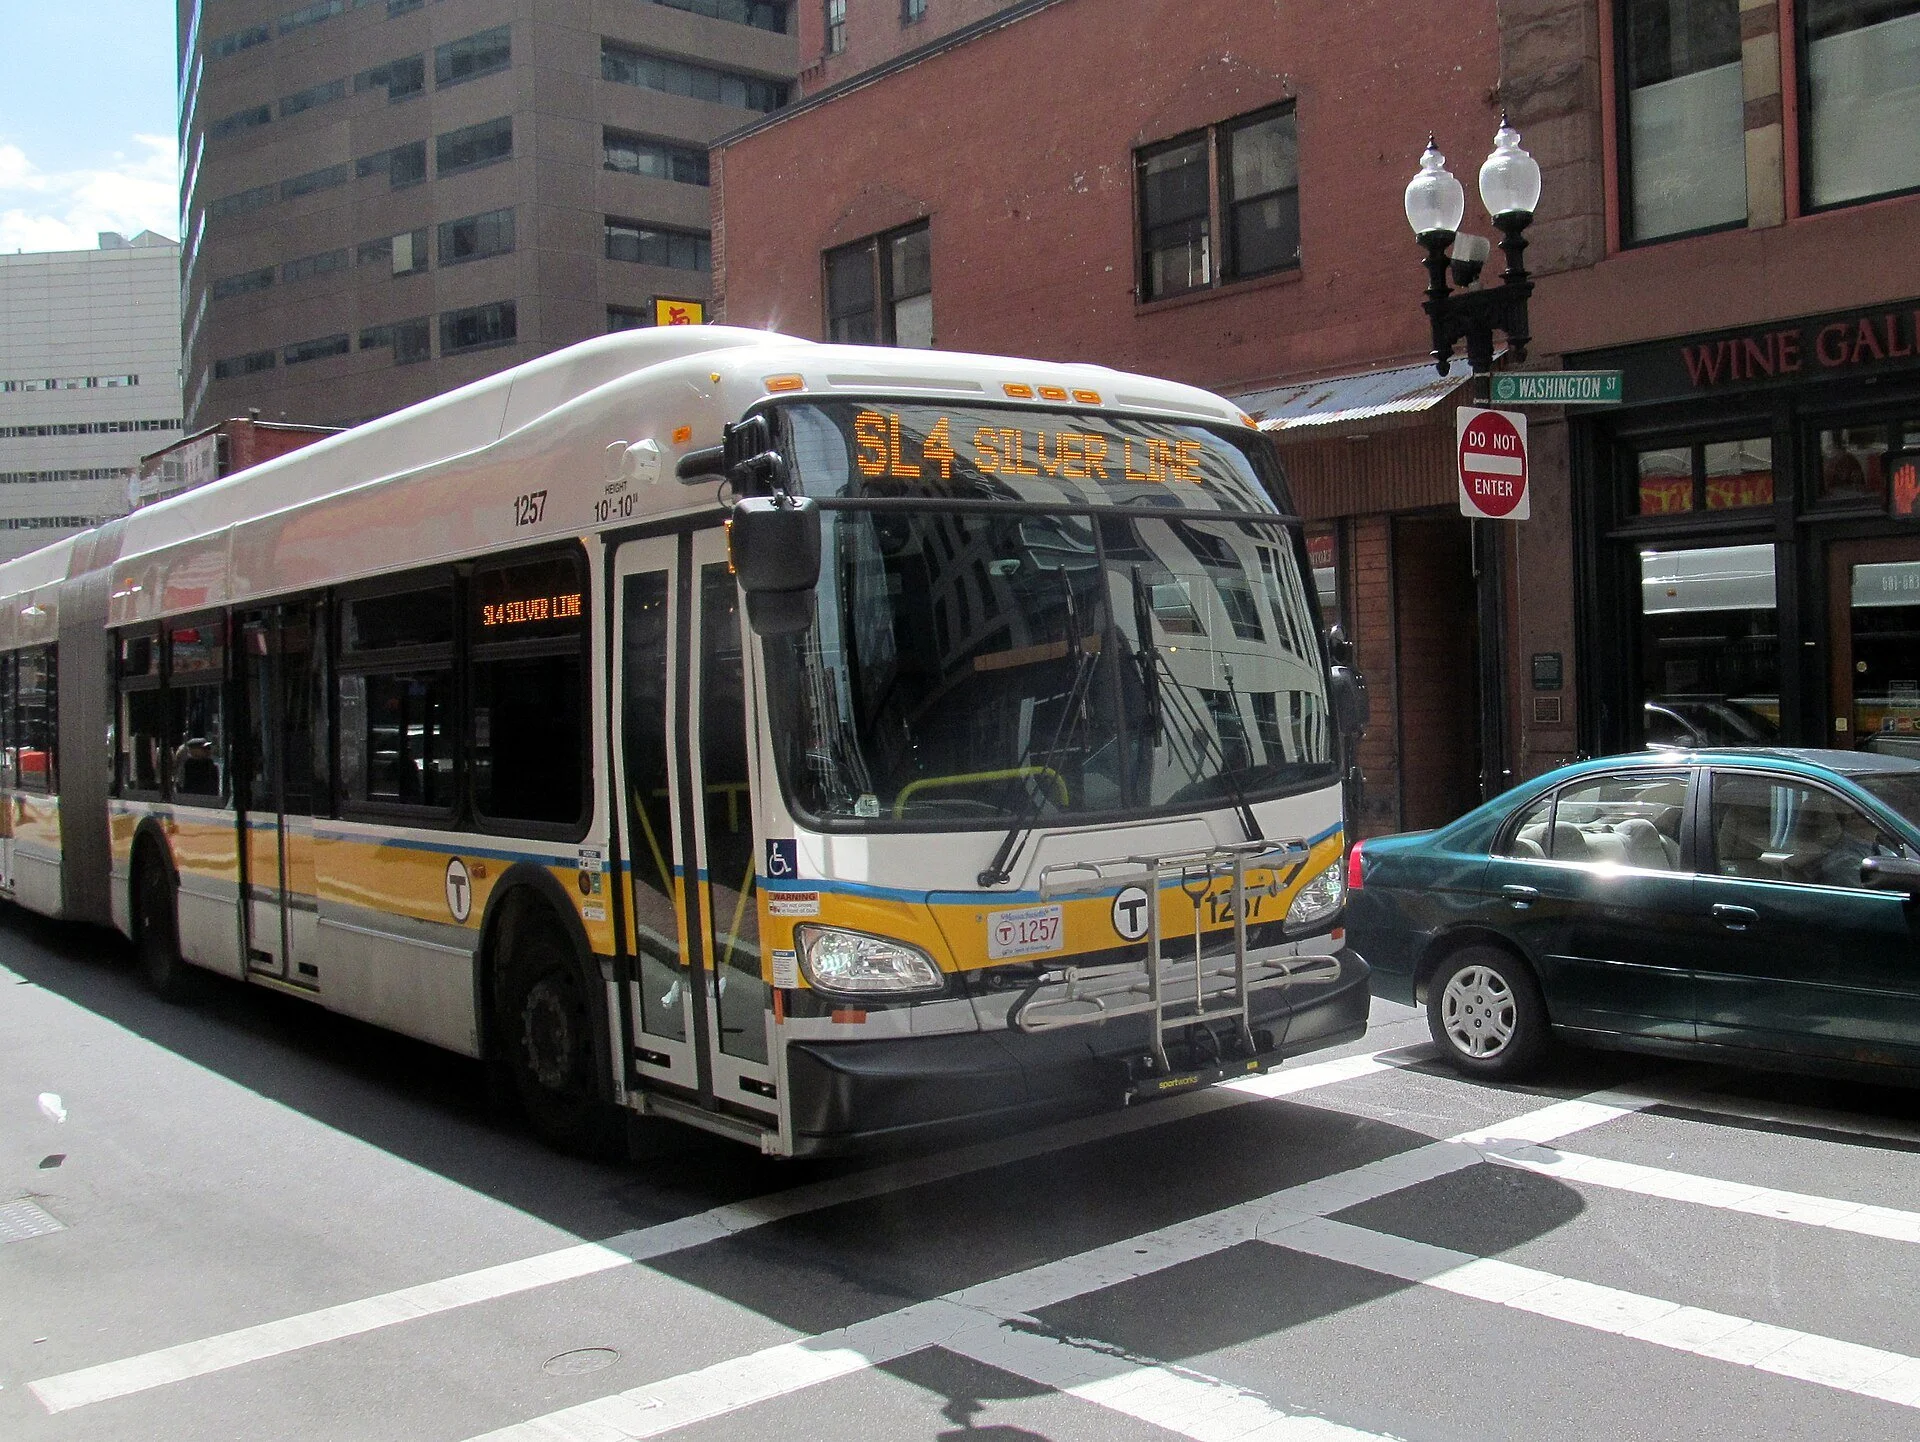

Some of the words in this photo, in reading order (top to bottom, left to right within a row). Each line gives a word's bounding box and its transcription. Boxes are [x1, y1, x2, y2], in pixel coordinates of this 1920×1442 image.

[1682, 329, 1802, 386] WINE
[1519, 377, 1600, 398] WASHINGTON
[1606, 377, 1616, 390] ST
[1469, 431, 1486, 448] DO
[1494, 434, 1516, 451] NOT
[973, 427, 1108, 479] SILVER
[1125, 437, 1202, 483] LINE
[605, 481, 627, 495] HEIGHT
[1475, 479, 1513, 496] ENTER
[514, 490, 547, 526] 1257
[506, 599, 548, 622] SILVER
[553, 594, 580, 617] LINE
[449, 875, 466, 912] T
[774, 893, 815, 901] WARNING
[1119, 898, 1147, 932] T
[999, 927, 1011, 941] T
[1019, 917, 1059, 944] 1257
[1159, 1076, 1198, 1089] sportworks
